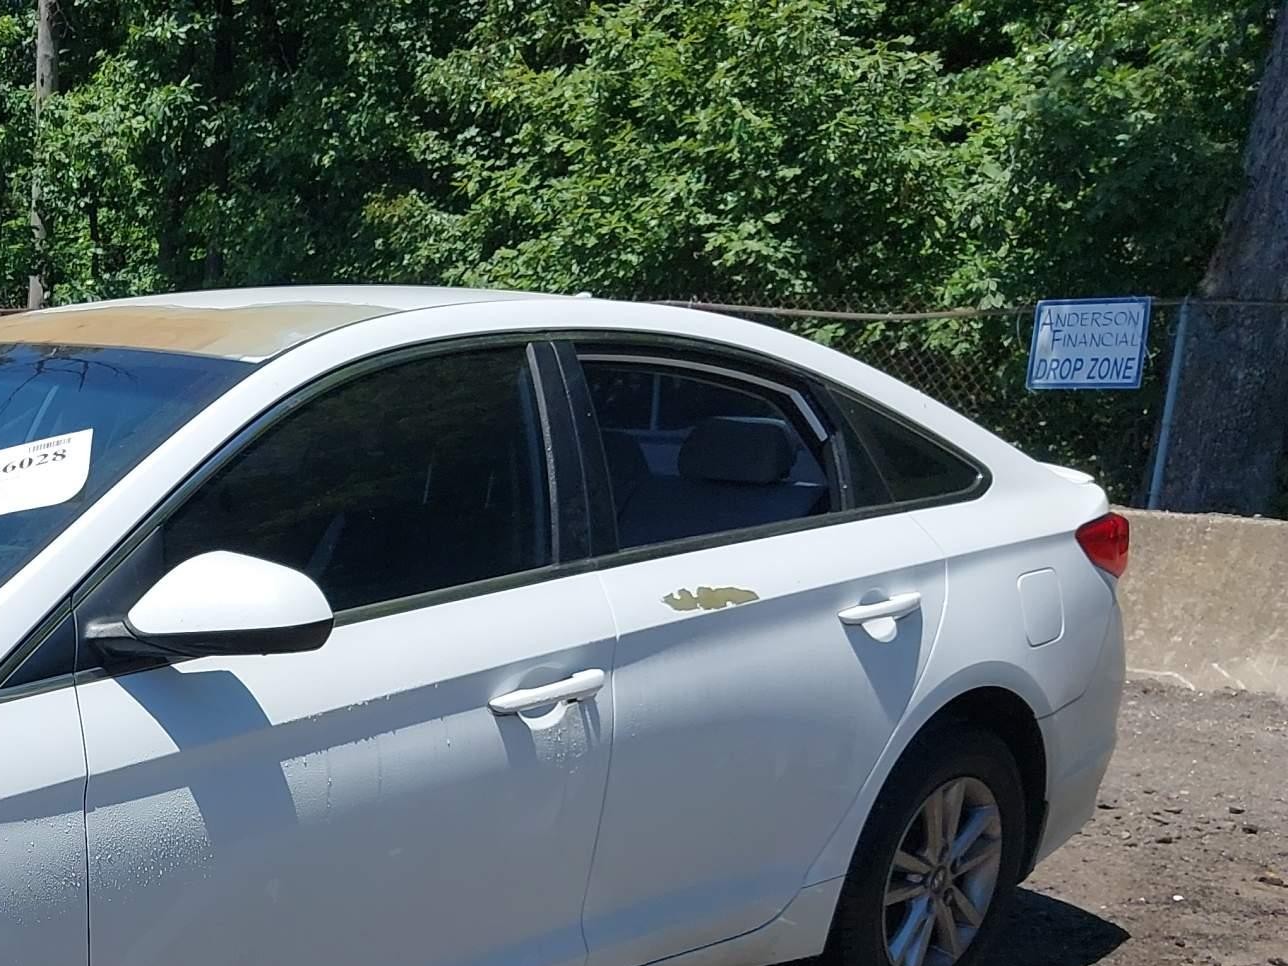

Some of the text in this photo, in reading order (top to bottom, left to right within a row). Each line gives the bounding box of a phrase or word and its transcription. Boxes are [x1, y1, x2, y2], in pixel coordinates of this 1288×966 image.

[1040, 309, 1140, 332] ANDERSON
[1052, 330, 1139, 351] FINANCIAL
[1035, 357, 1136, 380] DROP ZONE
